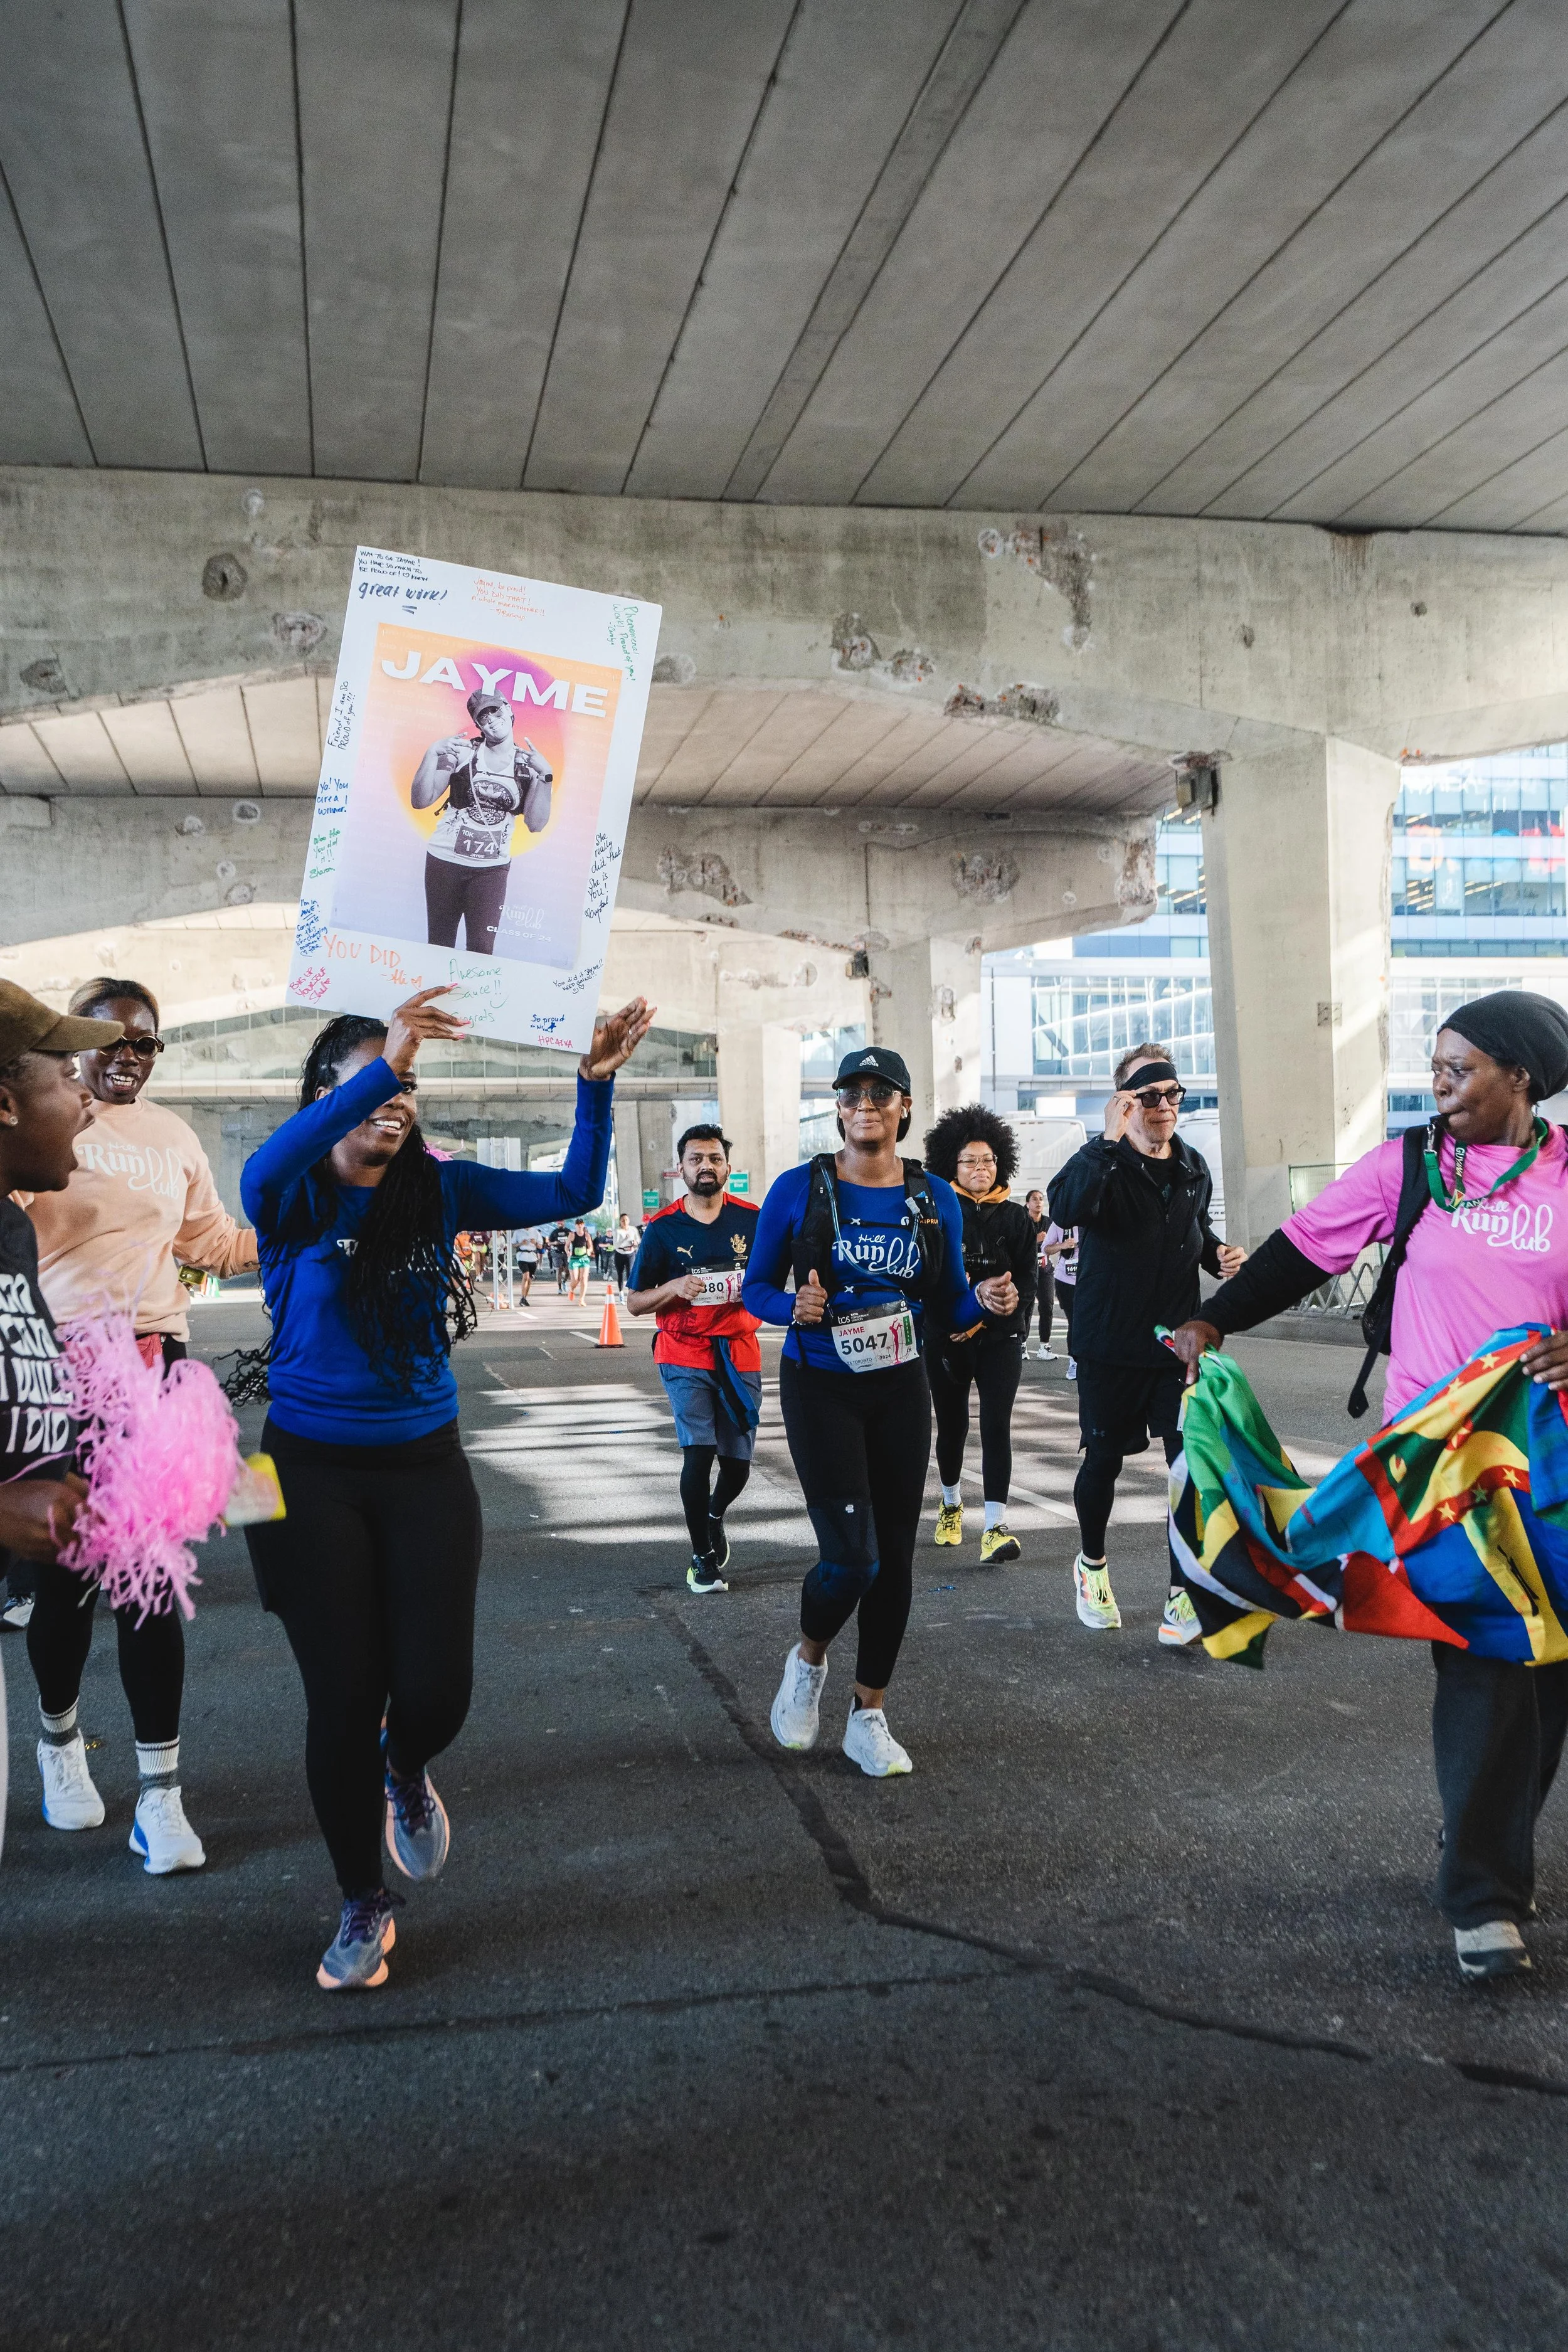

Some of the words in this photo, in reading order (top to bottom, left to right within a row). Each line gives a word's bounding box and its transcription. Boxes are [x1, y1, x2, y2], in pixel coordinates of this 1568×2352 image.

[358, 582, 400, 599] great
[477, 586, 488, 596] YOU
[381, 652, 608, 718] JAYME
[327, 718, 342, 747] Friend
[335, 706, 342, 715] I
[339, 694, 346, 704] am
[337, 726, 351, 750] PROUD
[344, 716, 351, 724] of
[334, 778, 348, 791] You
[596, 832, 608, 846] She
[595, 840, 612, 857] really
[591, 857, 607, 873] did
[589, 878, 600, 889] She
[602, 872, 608, 881] is
[487, 926, 521, 936] CLASS
[323, 934, 362, 958] YOU
[370, 944, 401, 968] DID
[449, 958, 502, 982] Awesome
[543, 1014, 564, 1025] proud
[1456, 1147, 1466, 1177] GUYANA
[75, 1143, 146, 1176] Run
[127, 1147, 181, 1199] Club
[1451, 1205, 1509, 1234] Run
[1486, 1204, 1553, 1252] Club
[859, 1234, 886, 1244] Hill
[832, 1240, 884, 1264] Run
[868, 1237, 920, 1278] Club
[837, 1316, 850, 1325] tcs
[839, 1327, 865, 1337] JAYME
[840, 1332, 887, 1355] 5047
[5, 1406, 20, 1453] I
[22, 1406, 69, 1453] DID
